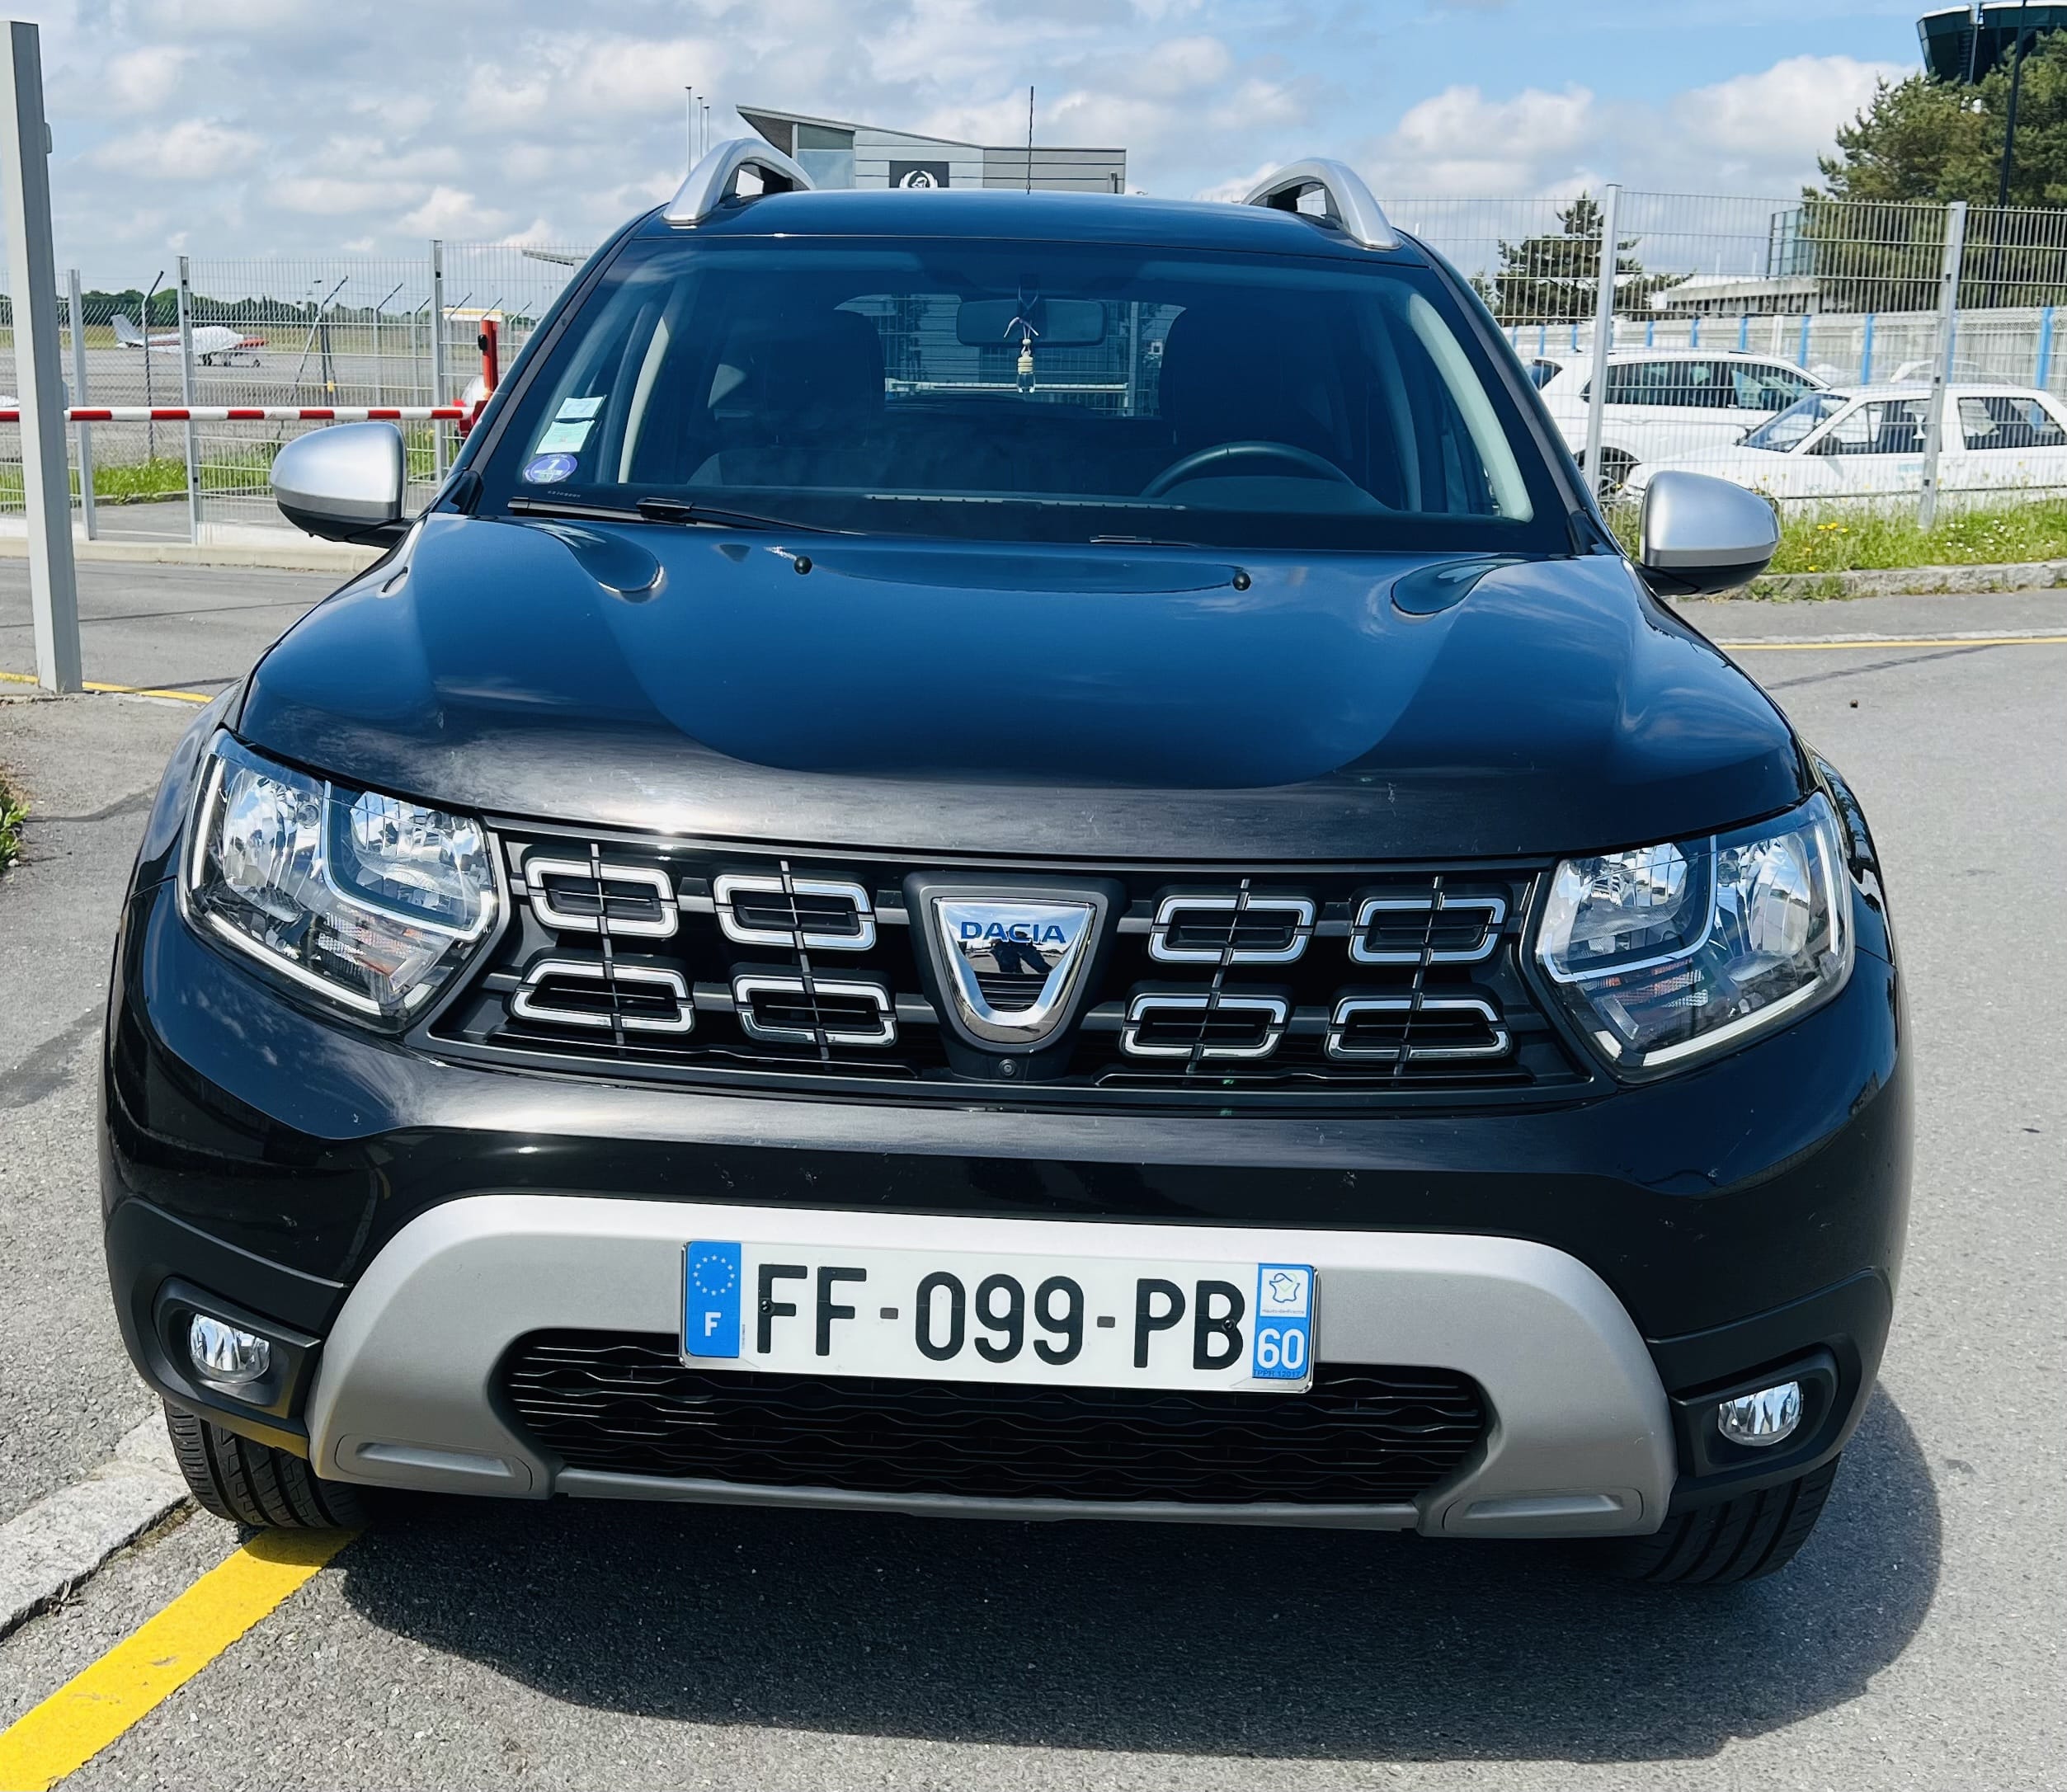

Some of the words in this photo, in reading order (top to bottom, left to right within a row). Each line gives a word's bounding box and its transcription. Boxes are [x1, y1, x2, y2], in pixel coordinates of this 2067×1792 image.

[961, 921, 1066, 943] DACIA
[704, 1311, 722, 1337] F
[1257, 1328, 1305, 1369] 60
